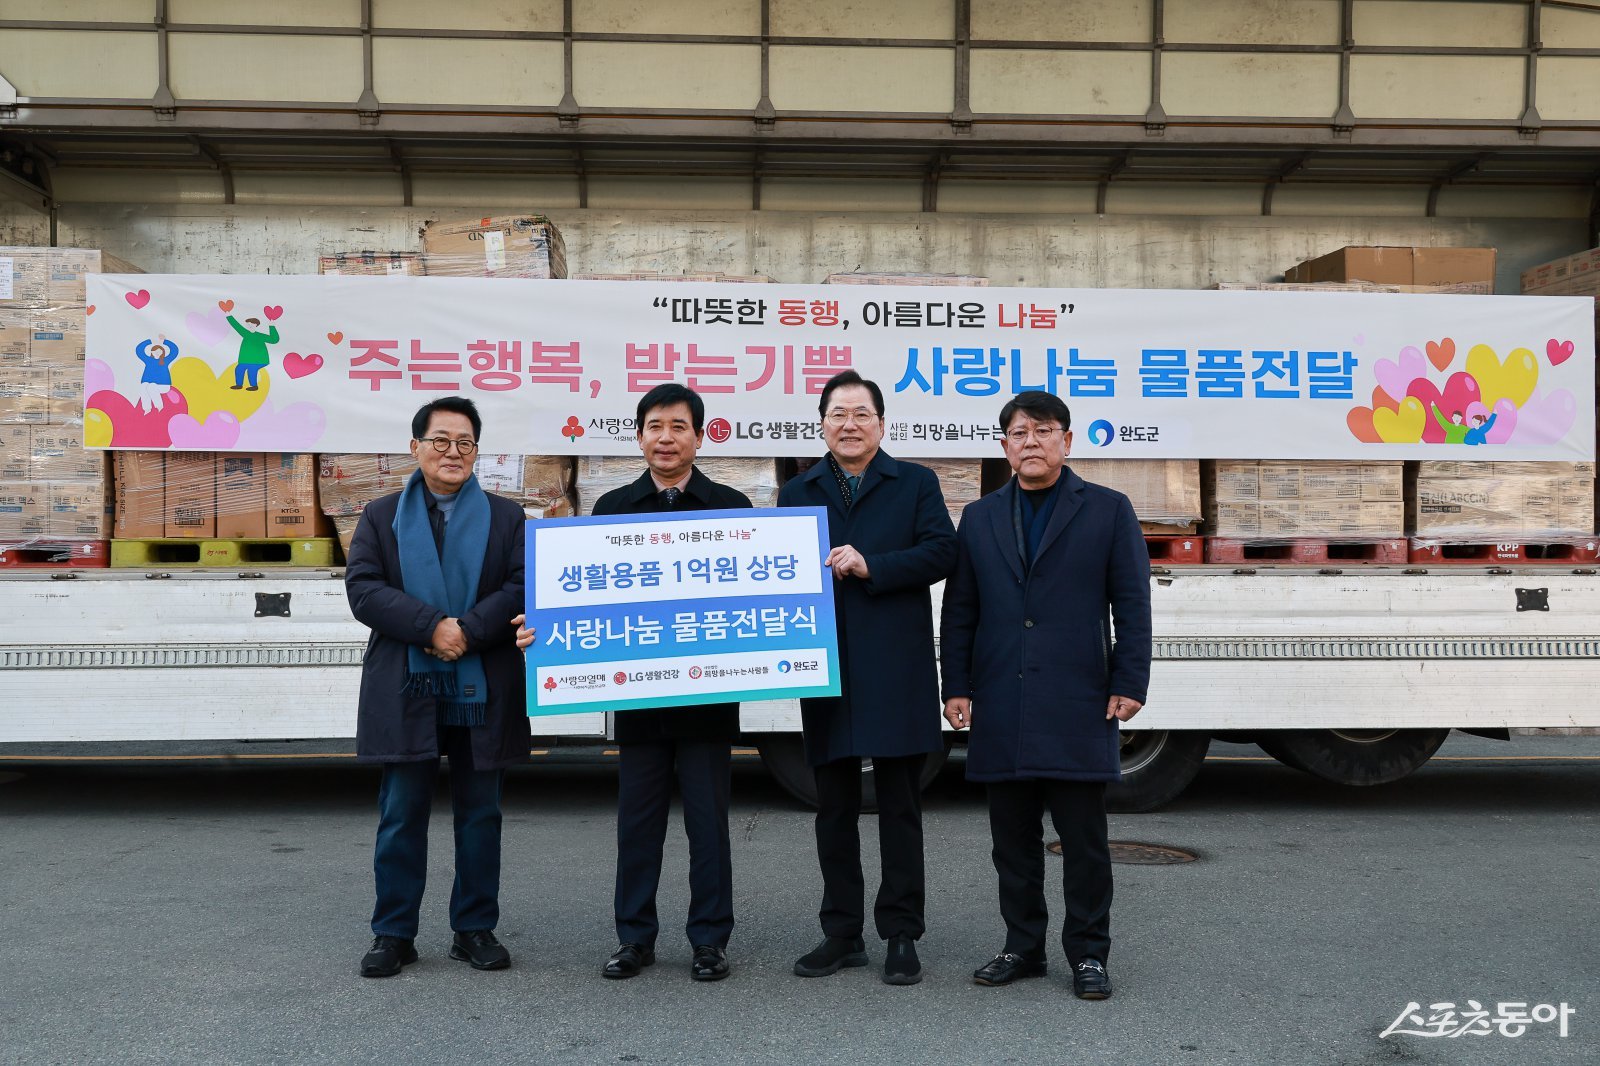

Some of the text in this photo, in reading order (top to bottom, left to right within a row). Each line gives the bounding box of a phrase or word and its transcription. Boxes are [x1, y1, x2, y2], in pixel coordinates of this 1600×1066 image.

[652, 296, 1075, 331] “따뜻한 동행, 아름다운 나눔”
[349, 339, 602, 398] 주는행복,
[895, 347, 1118, 398] 사랑나눔
[1138, 349, 1358, 399] 물품전달
[1119, 425, 1160, 442] 완도군
[678, 529, 725, 543] 아름다운
[1497, 543, 1519, 551] KPP
[558, 554, 799, 592] 생활용품 1억원 상당
[545, 605, 817, 651] 사랑나눔 물품전달식
[793, 660, 819, 672] 완도군
[559, 674, 606, 687] 사랑의열매
